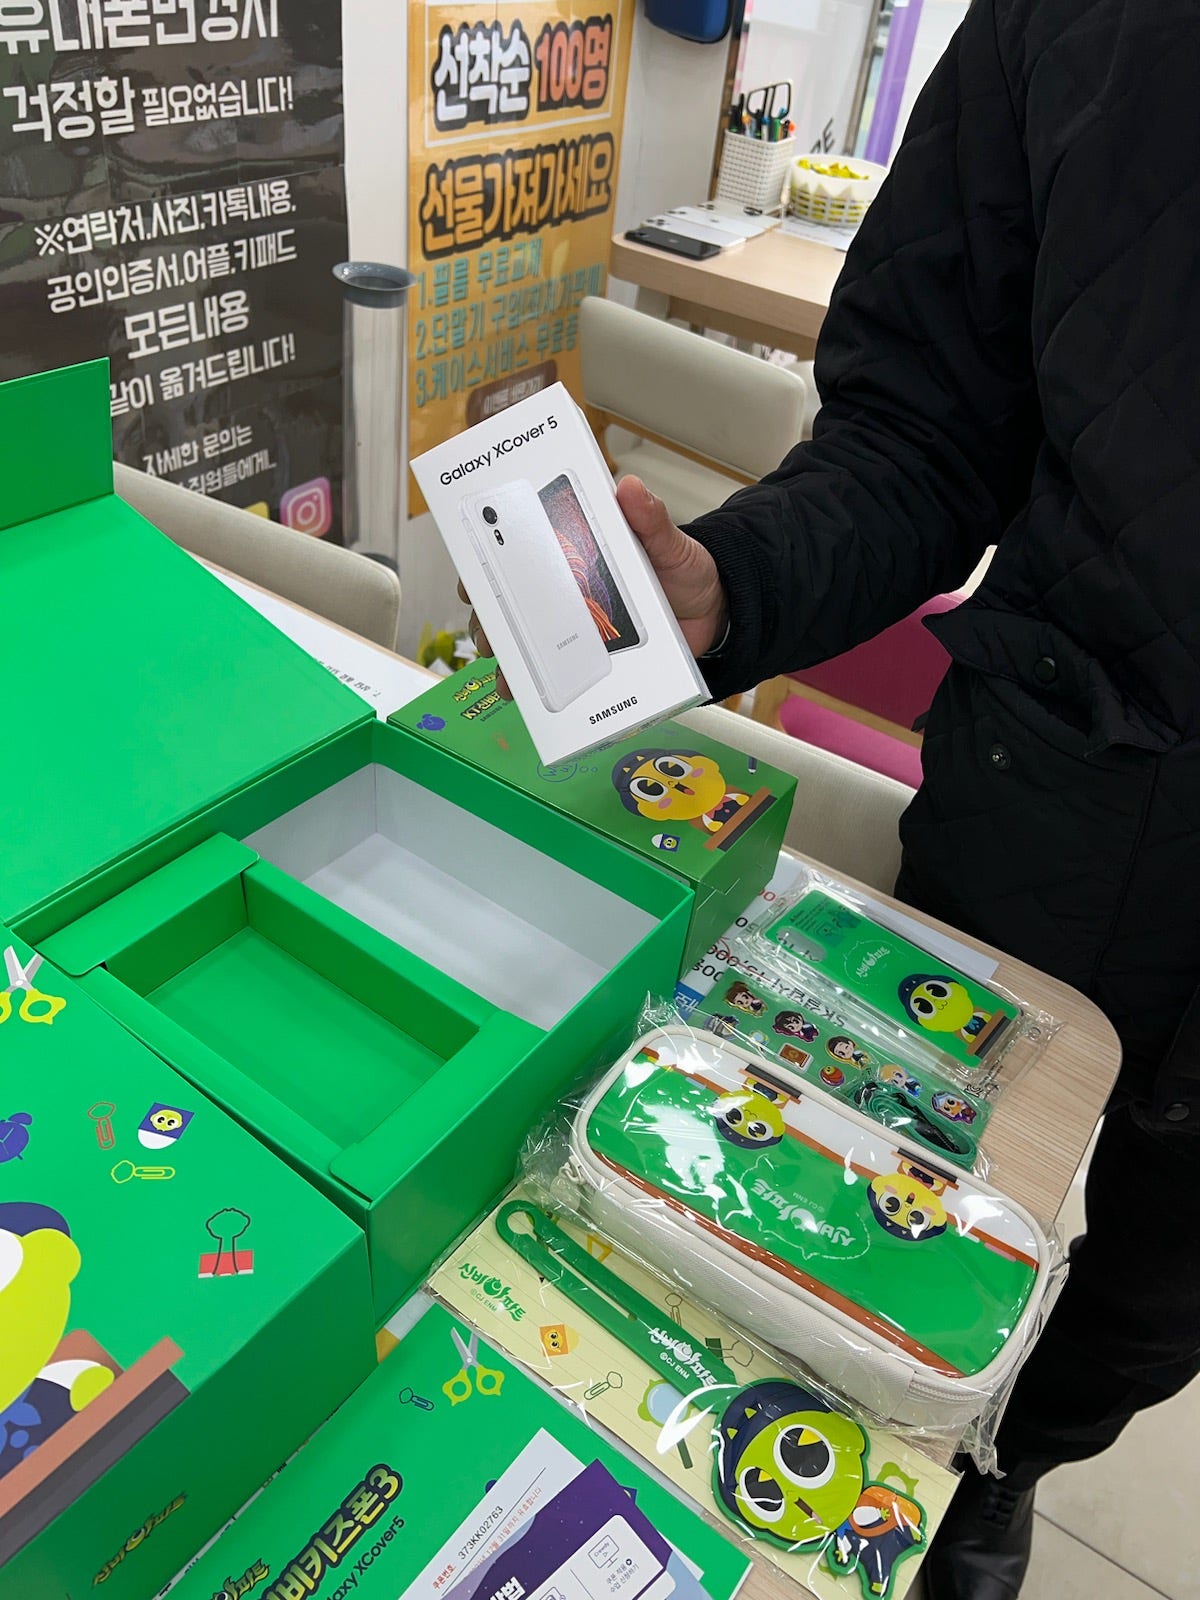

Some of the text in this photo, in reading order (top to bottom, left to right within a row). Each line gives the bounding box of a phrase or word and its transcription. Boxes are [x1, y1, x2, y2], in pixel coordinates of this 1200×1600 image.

[433, 20, 612, 126] 선착순 100명
[3, 76, 294, 142] 걱정할 필요없습니다!
[421, 137, 614, 256] 선물가져가세요
[124, 289, 250, 360] 모든내용
[159, 333, 297, 401] 옮겨드립니다!
[143, 424, 253, 477] 자세한 문의는
[440, 415, 558, 486] Galaxy XCover 5
[556, 632, 579, 651] SAMSUNG
[589, 695, 639, 725] SAMSUNG
[458, 1263, 526, 1322] 신비아파트
[674, 1364, 690, 1380] ENM
[353, 1514, 405, 1577] XCover5
[457, 1505, 504, 1560] 373KK02763
